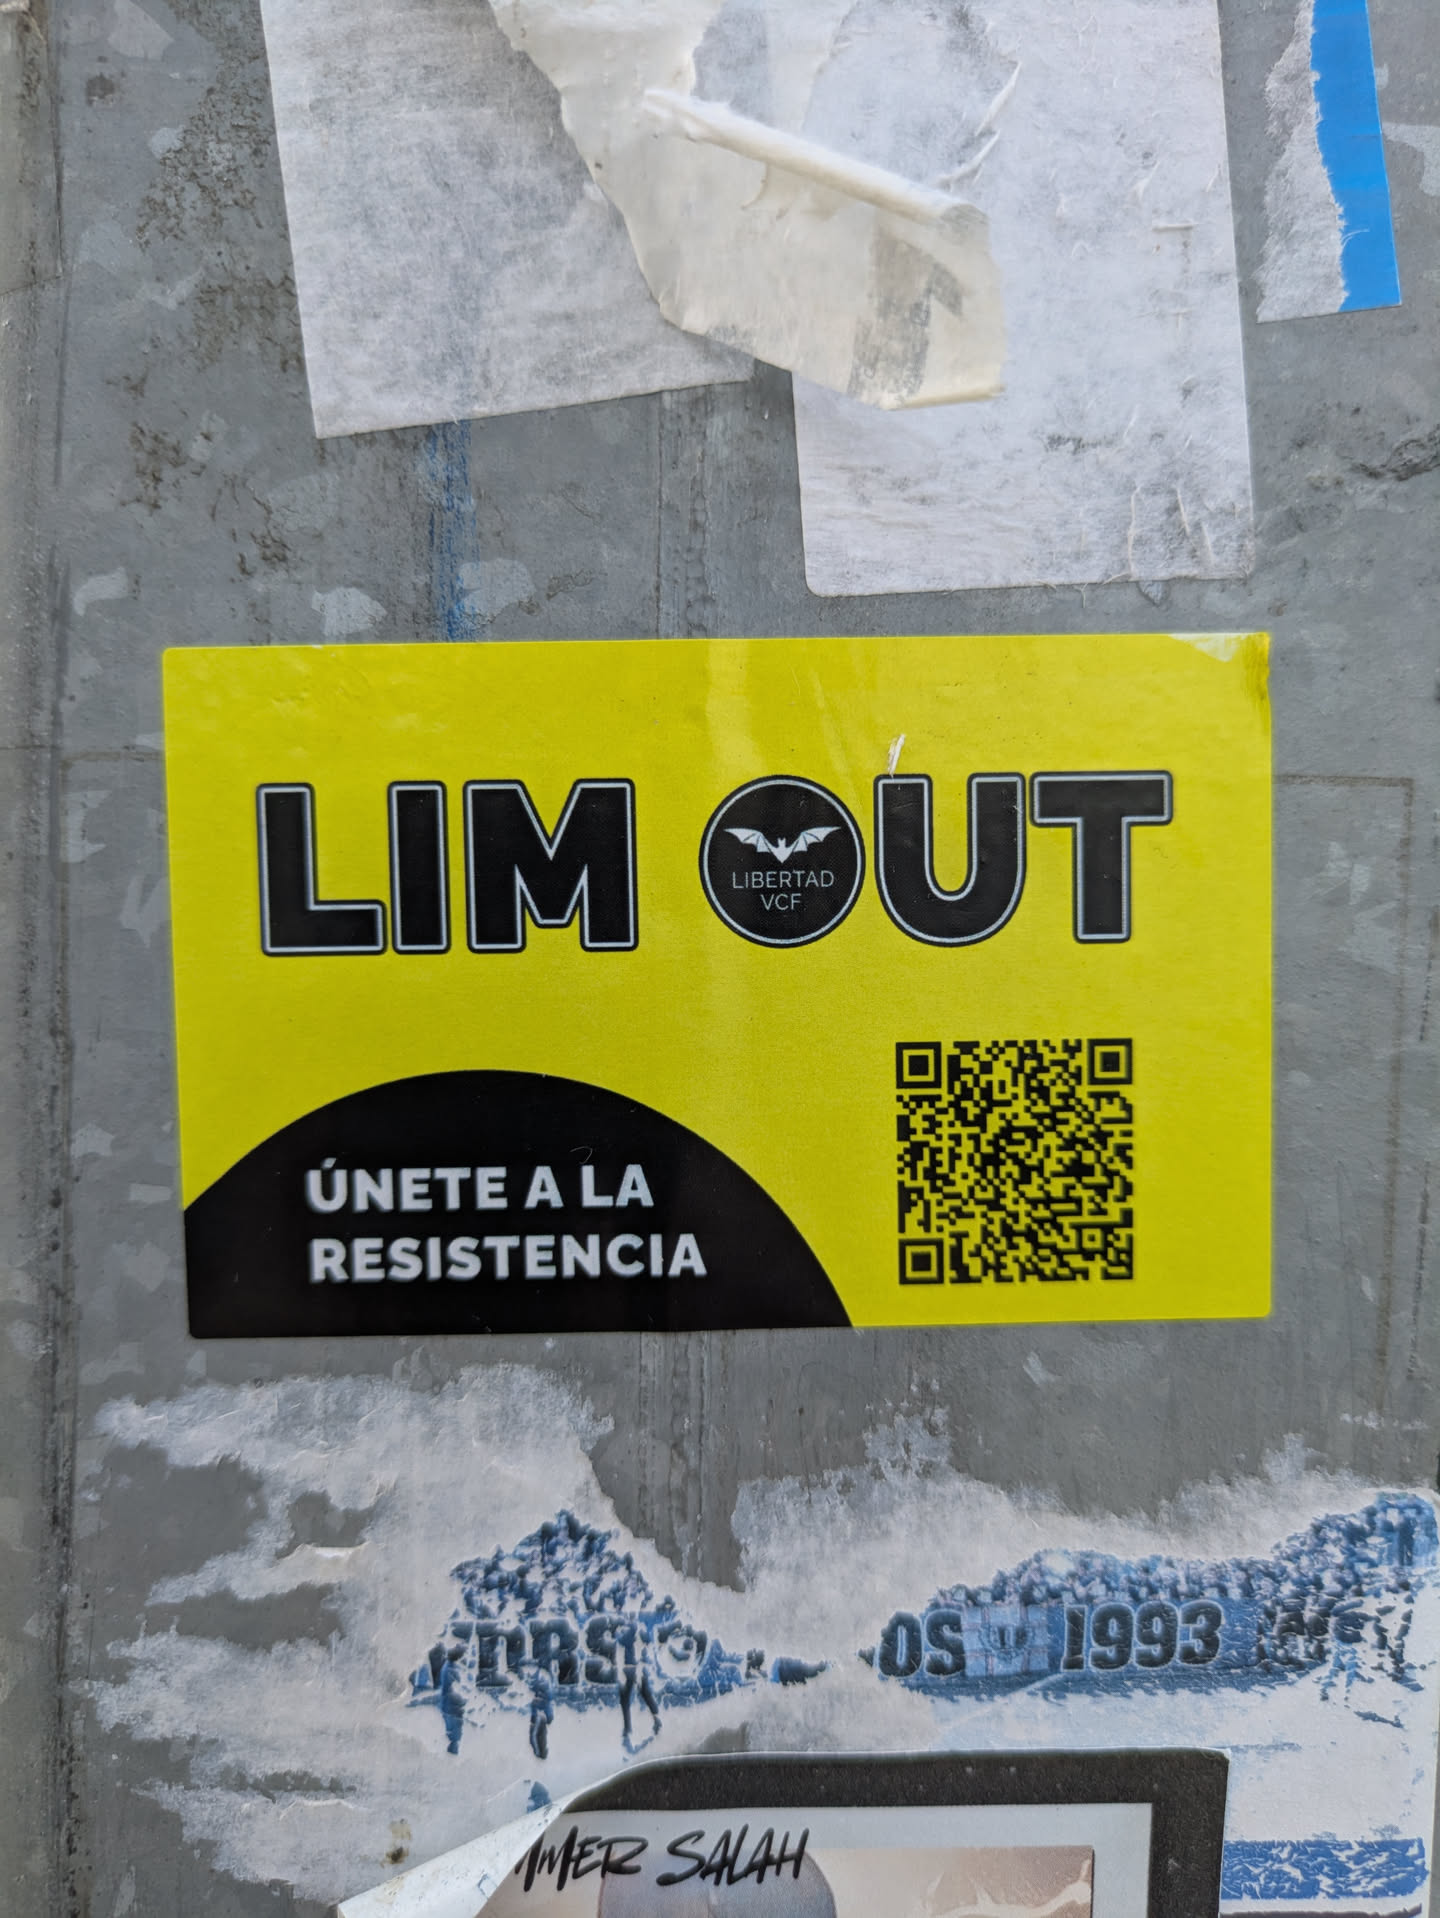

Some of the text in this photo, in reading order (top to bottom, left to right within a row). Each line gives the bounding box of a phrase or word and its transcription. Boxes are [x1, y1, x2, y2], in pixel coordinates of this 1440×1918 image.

[255, 770, 1173, 956] LIM OUT
[732, 870, 835, 889] LIBERTAD
[760, 893, 802, 911] VCF
[305, 1157, 655, 1213] ÚNETE A LA
[309, 1233, 708, 1284] RESISTENCIA
[857, 1610, 966, 1678] OS
[1061, 1599, 1224, 1673] 1993
[656, 1823, 810, 1888] SALAH
